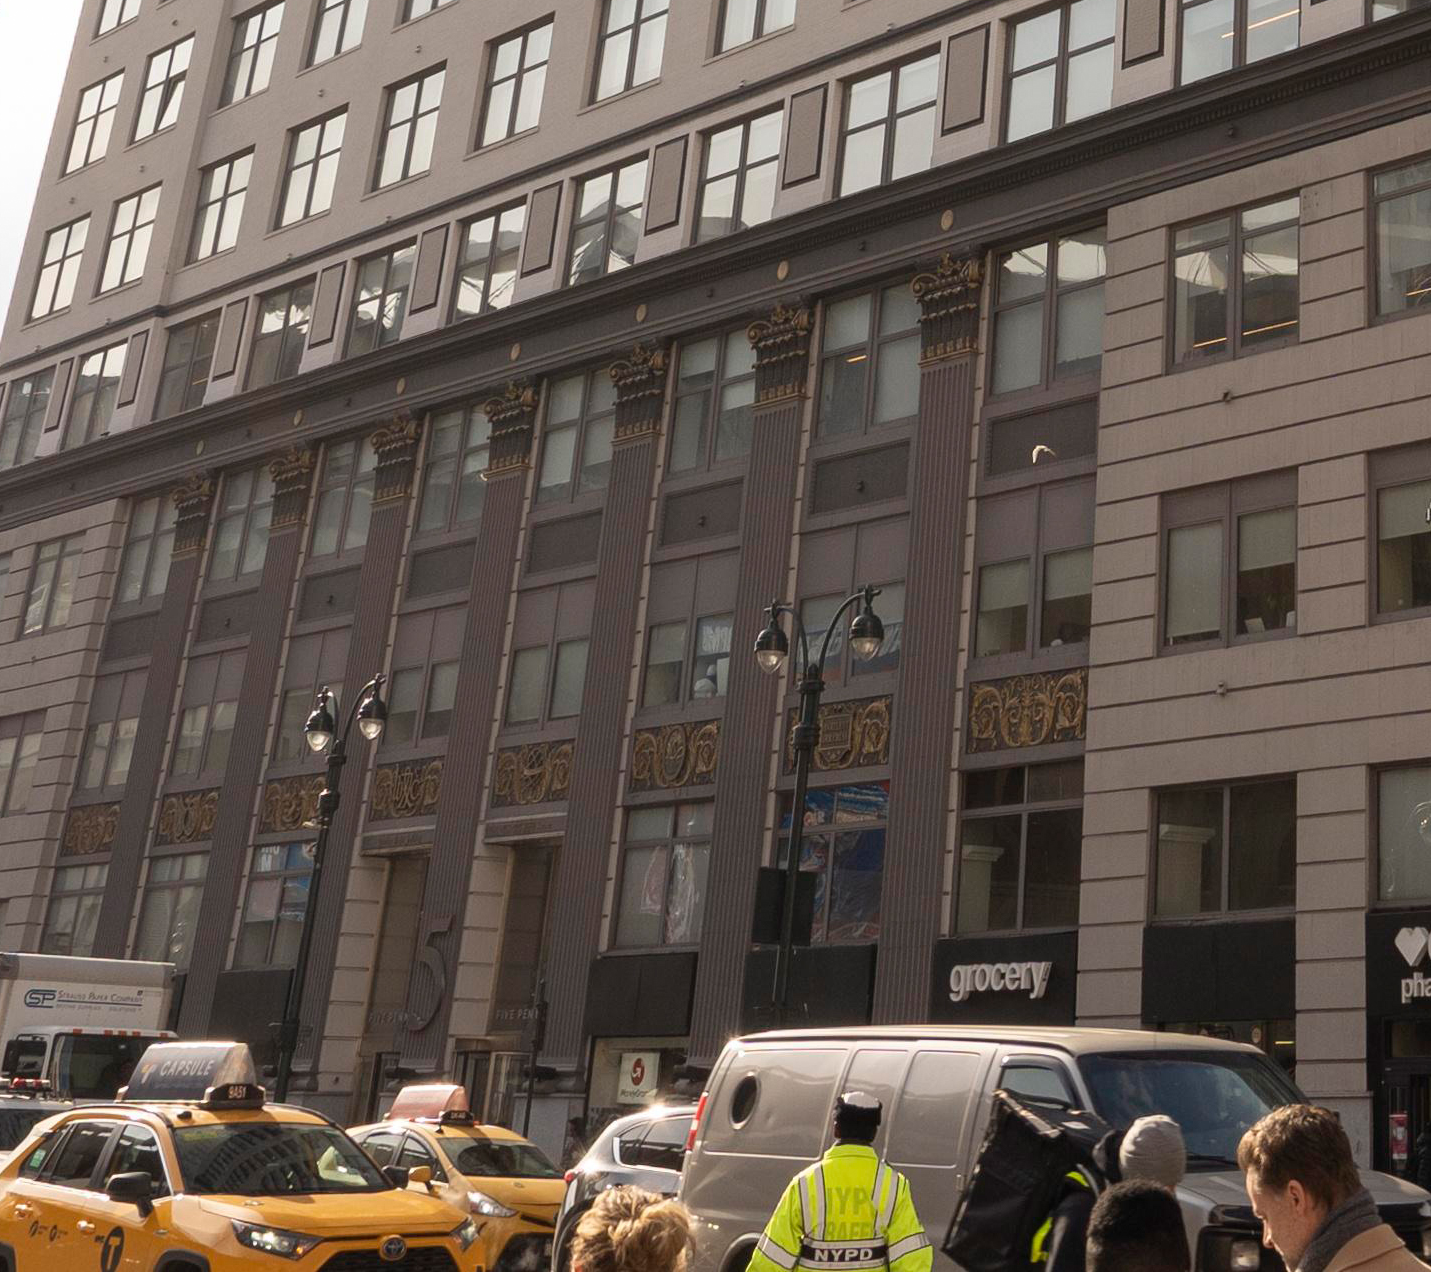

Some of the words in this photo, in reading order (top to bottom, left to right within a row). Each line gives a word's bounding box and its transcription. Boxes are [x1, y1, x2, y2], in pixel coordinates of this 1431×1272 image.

[405, 914, 457, 1032] 5
[949, 961, 1053, 1002] grocery
[496, 1009, 516, 1021] FIVE
[160, 1060, 216, 1076] CAPSULE
[814, 1248, 873, 1262] NYPD
